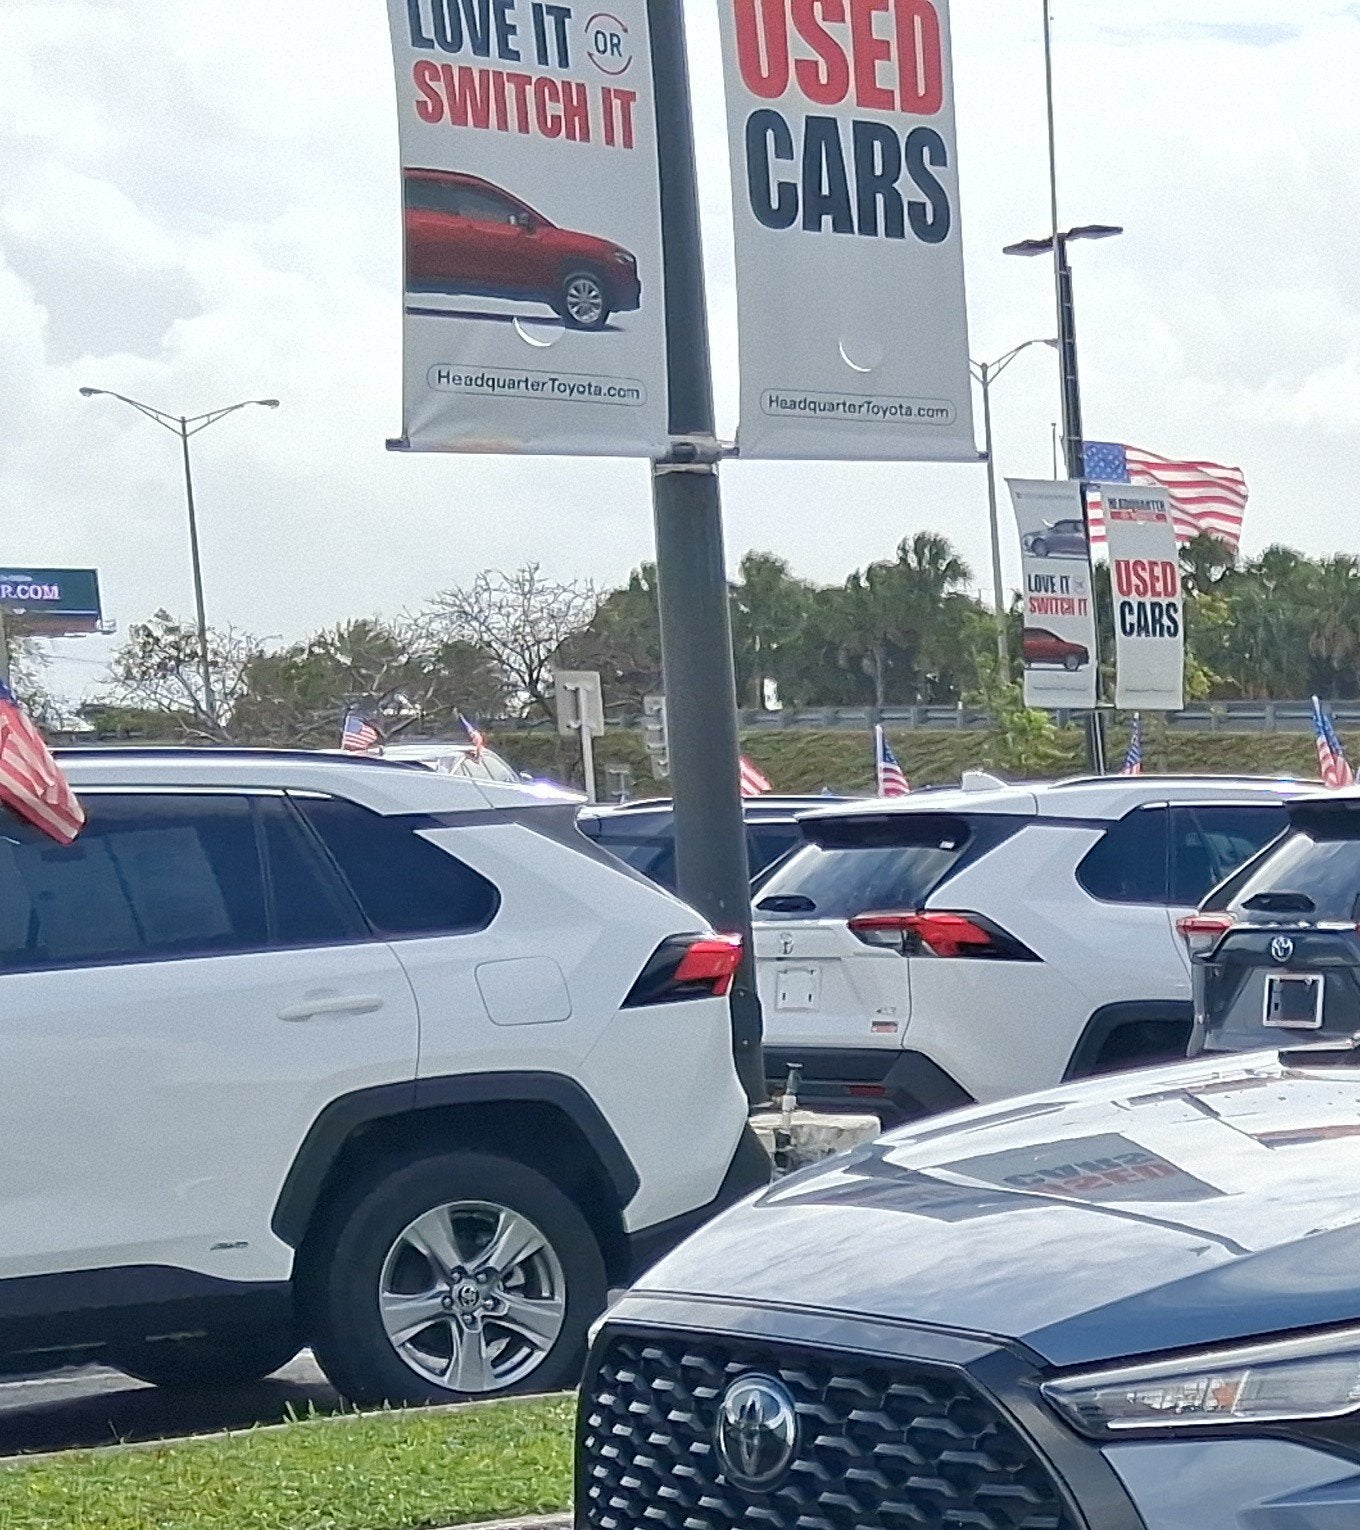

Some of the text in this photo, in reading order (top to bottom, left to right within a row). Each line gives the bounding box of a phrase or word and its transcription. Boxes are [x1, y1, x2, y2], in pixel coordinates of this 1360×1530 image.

[407, 0, 622, 69] LOVE IT OR
[734, 0, 943, 116] USED
[413, 60, 637, 150] SWITCH IT
[746, 108, 951, 244] CARS
[437, 369, 640, 400] HeadquarterToyota.com
[768, 395, 949, 419] HeadquarterToyota.com
[1028, 574, 1057, 594] LOVE
[1060, 575, 1070, 595] IT
[1115, 559, 1177, 598] USED
[1029, 596, 1088, 616] SWITCH IT
[1120, 600, 1179, 638] CARS
